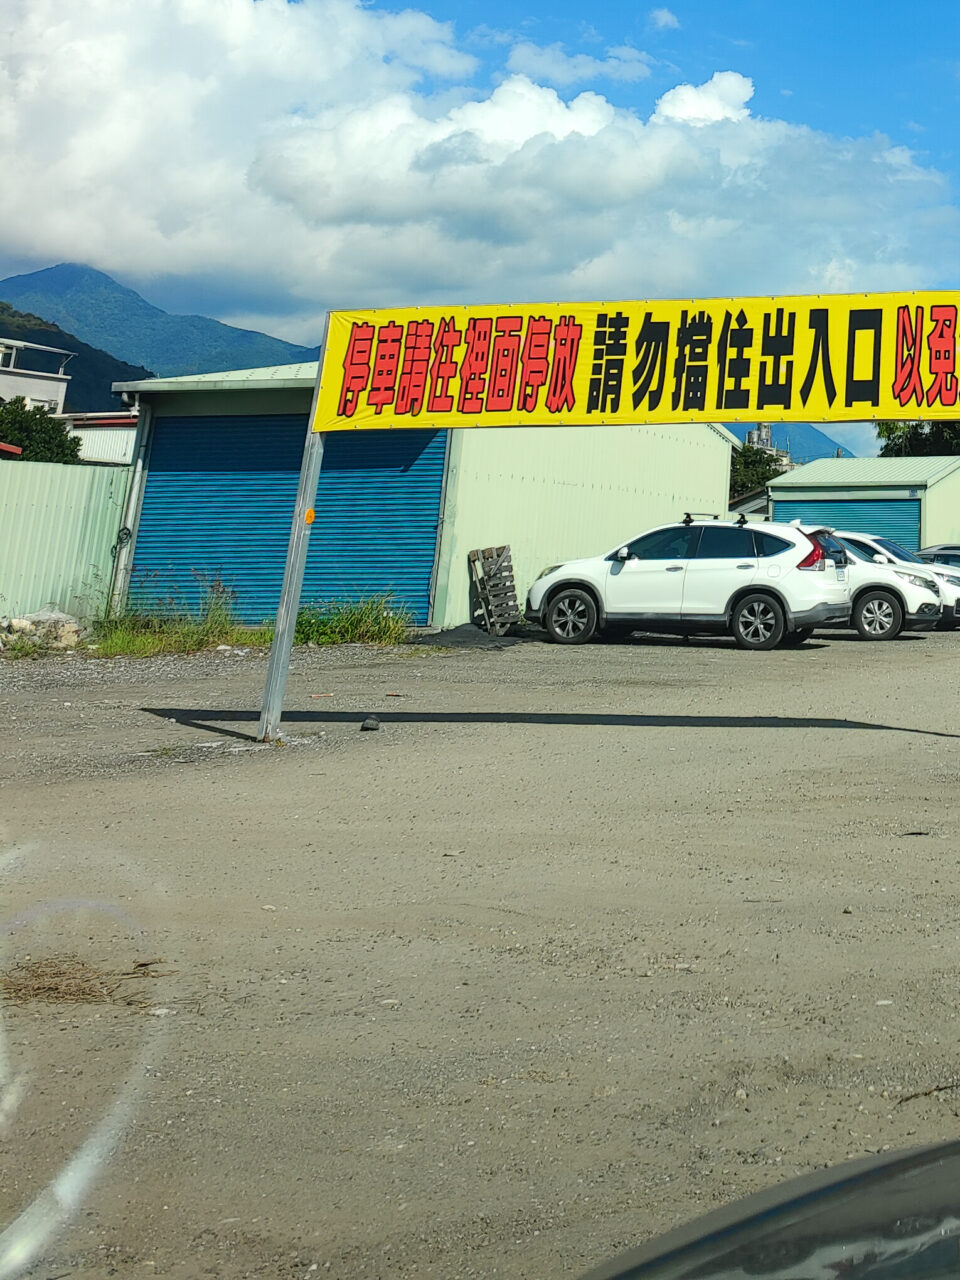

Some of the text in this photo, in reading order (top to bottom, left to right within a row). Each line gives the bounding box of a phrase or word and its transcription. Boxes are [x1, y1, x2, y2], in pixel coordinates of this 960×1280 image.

[337, 315, 583, 417] 停車請往裡面停放
[586, 308, 883, 414] 請勿擋住出入口
